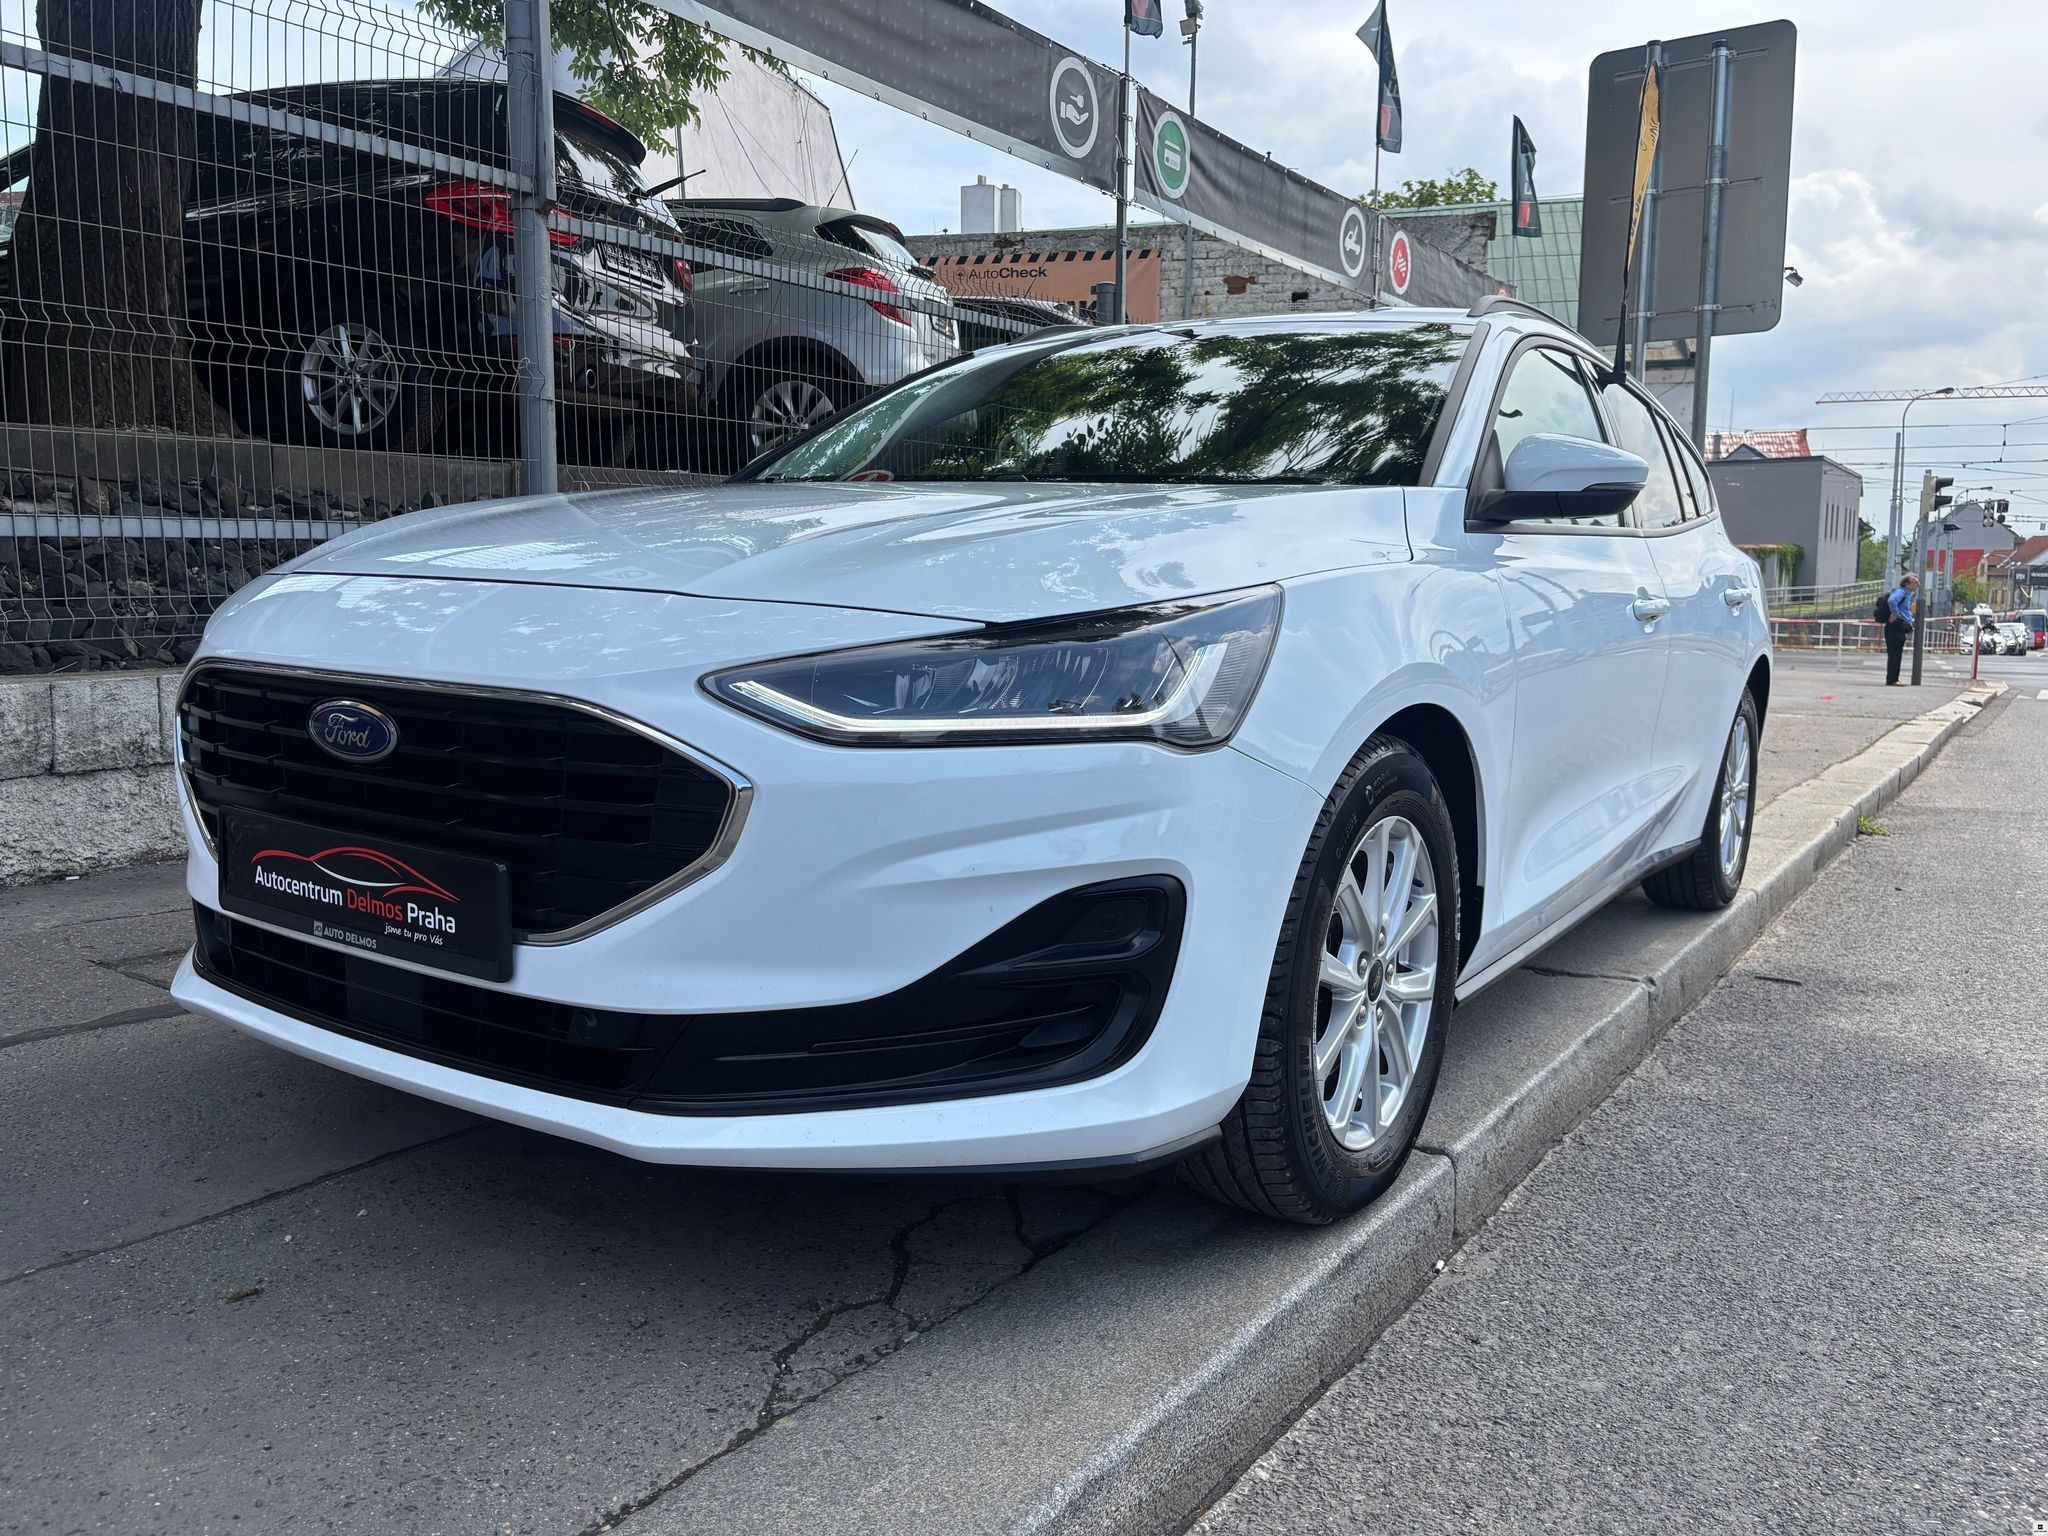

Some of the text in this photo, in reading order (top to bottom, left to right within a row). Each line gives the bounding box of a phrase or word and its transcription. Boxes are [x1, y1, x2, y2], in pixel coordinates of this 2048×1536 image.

[968, 267, 1047, 279] AutoCheck
[324, 712, 371, 748] Ford
[255, 865, 456, 934] Autocentrum Delmos Praha
[324, 927, 377, 949] AUTO DELMOS
[384, 922, 443, 945] jsme tu pro Vás
[1299, 1043, 1329, 1176] MICHELIN
